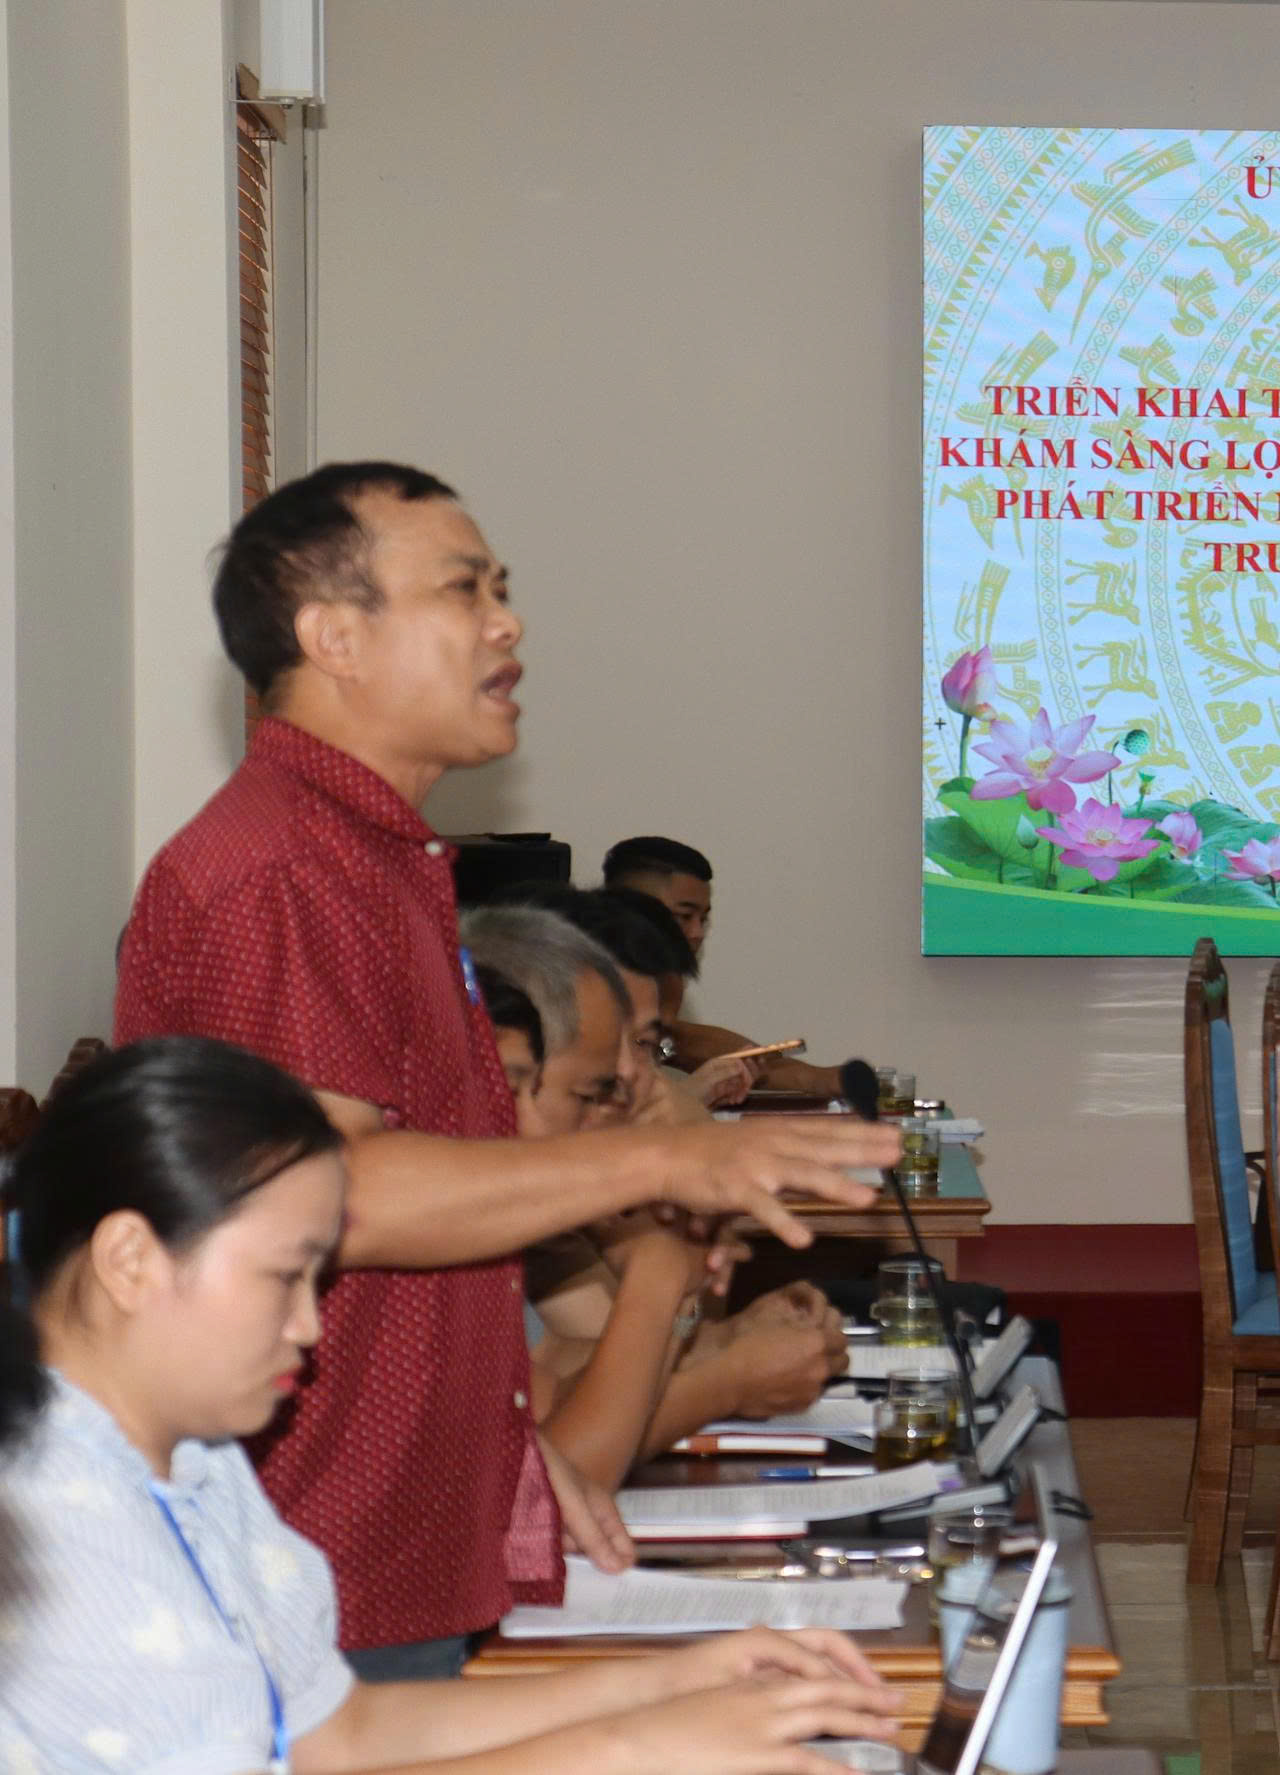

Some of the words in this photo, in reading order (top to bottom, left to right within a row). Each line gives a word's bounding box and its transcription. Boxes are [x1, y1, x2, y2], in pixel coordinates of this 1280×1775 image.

[985, 377, 1121, 418] TRIỂN
[1137, 387, 1249, 419] KHAI
[939, 428, 1076, 470] KHÁM
[1090, 430, 1211, 471] SÀNG
[995, 480, 1114, 522] PHÁT
[1126, 480, 1261, 522] TRIỂN
